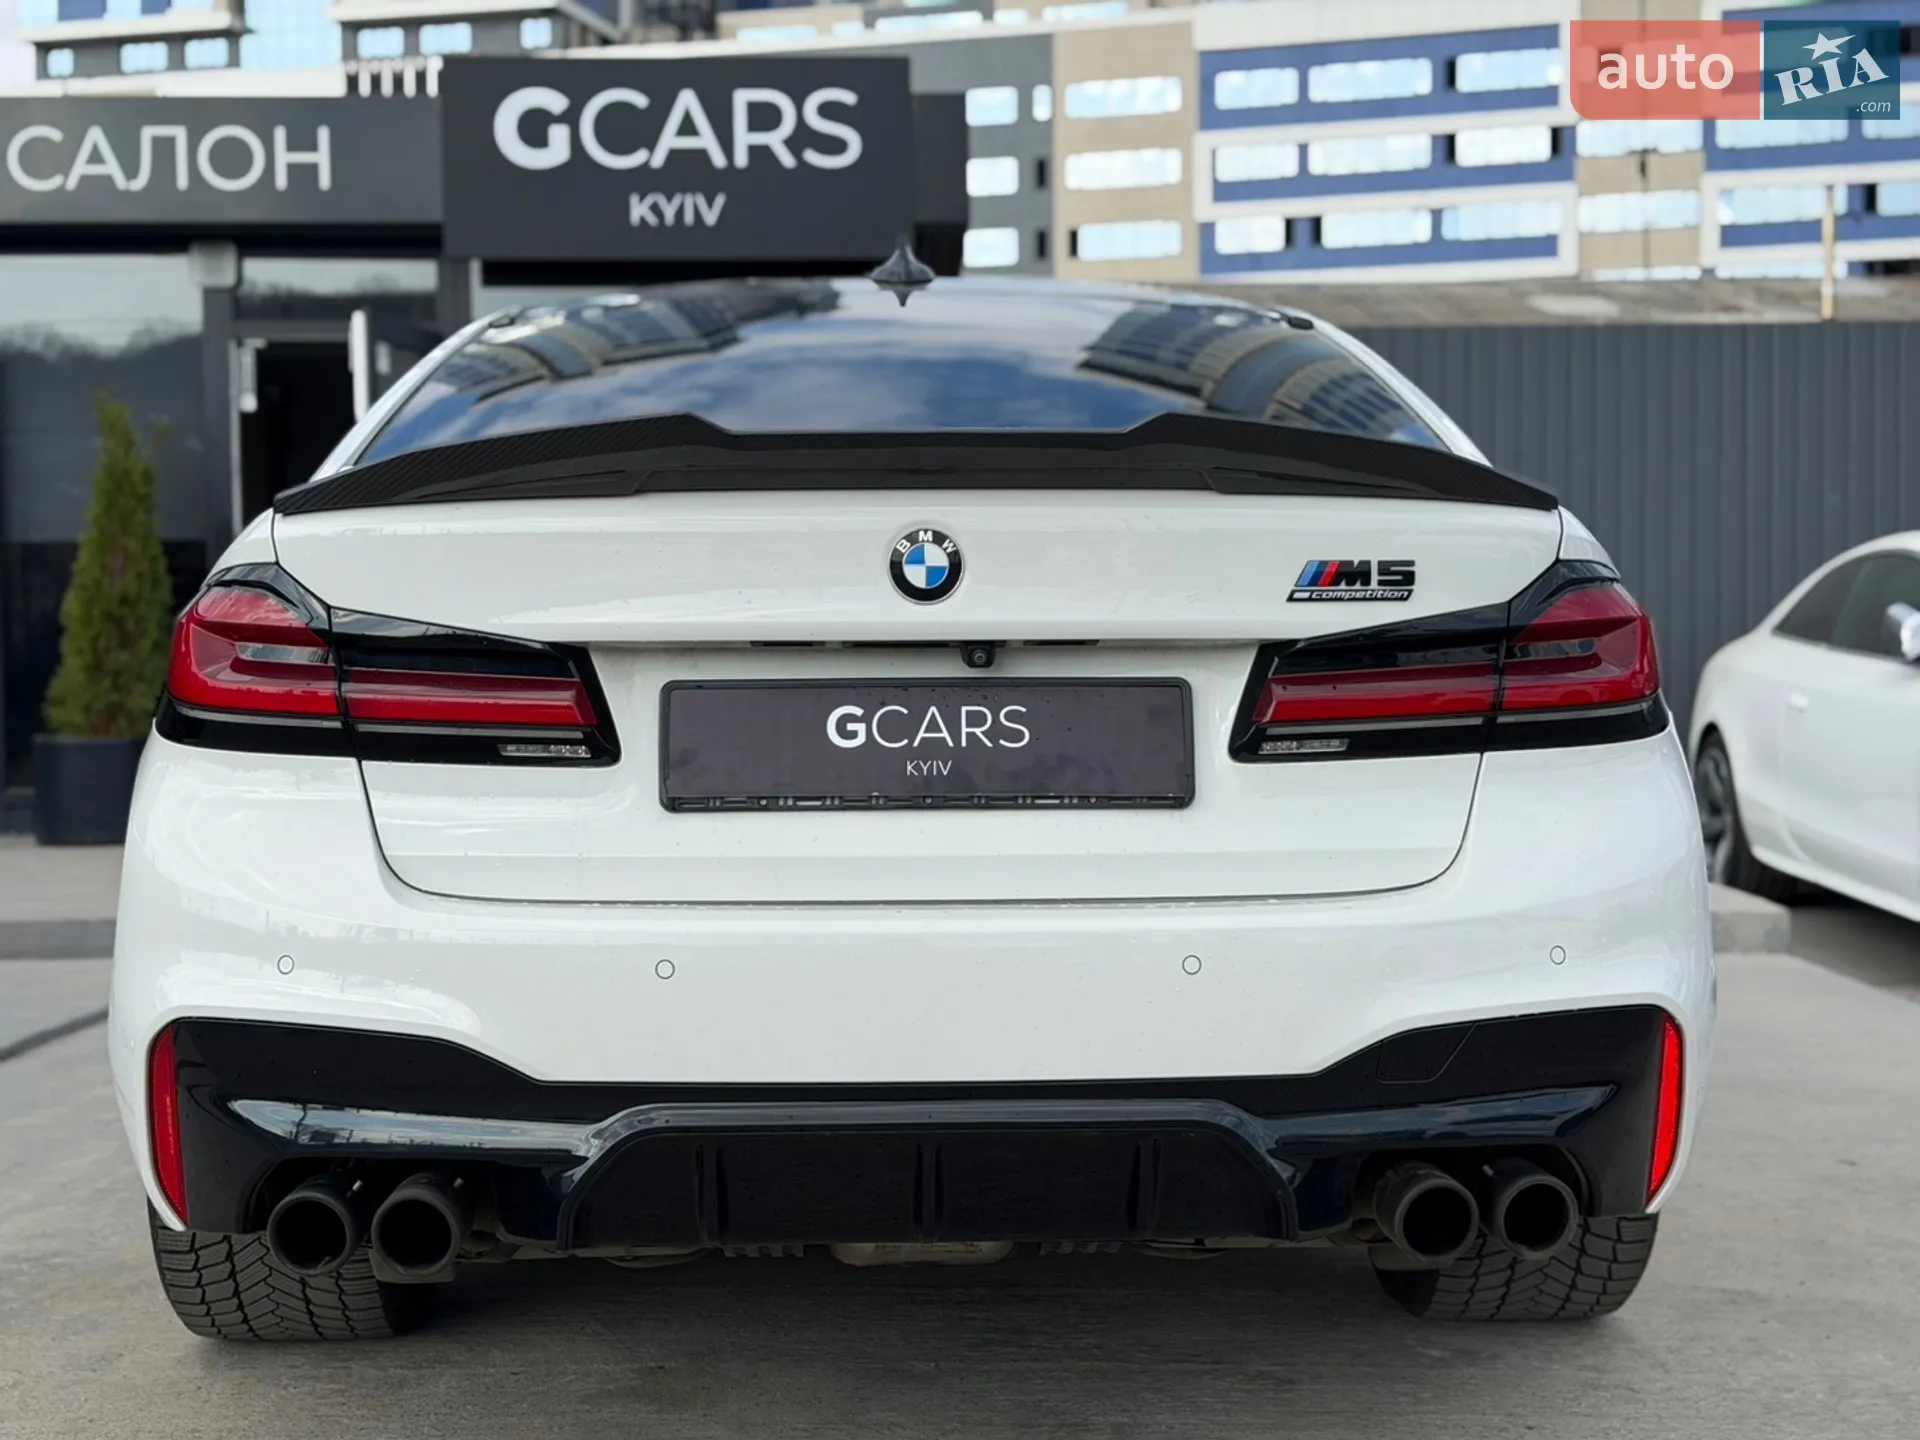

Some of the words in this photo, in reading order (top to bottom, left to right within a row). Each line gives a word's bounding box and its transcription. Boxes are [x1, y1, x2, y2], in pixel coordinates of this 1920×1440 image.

[493, 86, 863, 170] GCARS
[5, 123, 332, 193] САЛОН
[629, 193, 726, 226] KYIV
[896, 530, 957, 553] BMW
[1328, 559, 1416, 588] M5
[1311, 589, 1409, 600] competition
[826, 705, 1031, 749] GCARS
[906, 759, 952, 776] KYIV
